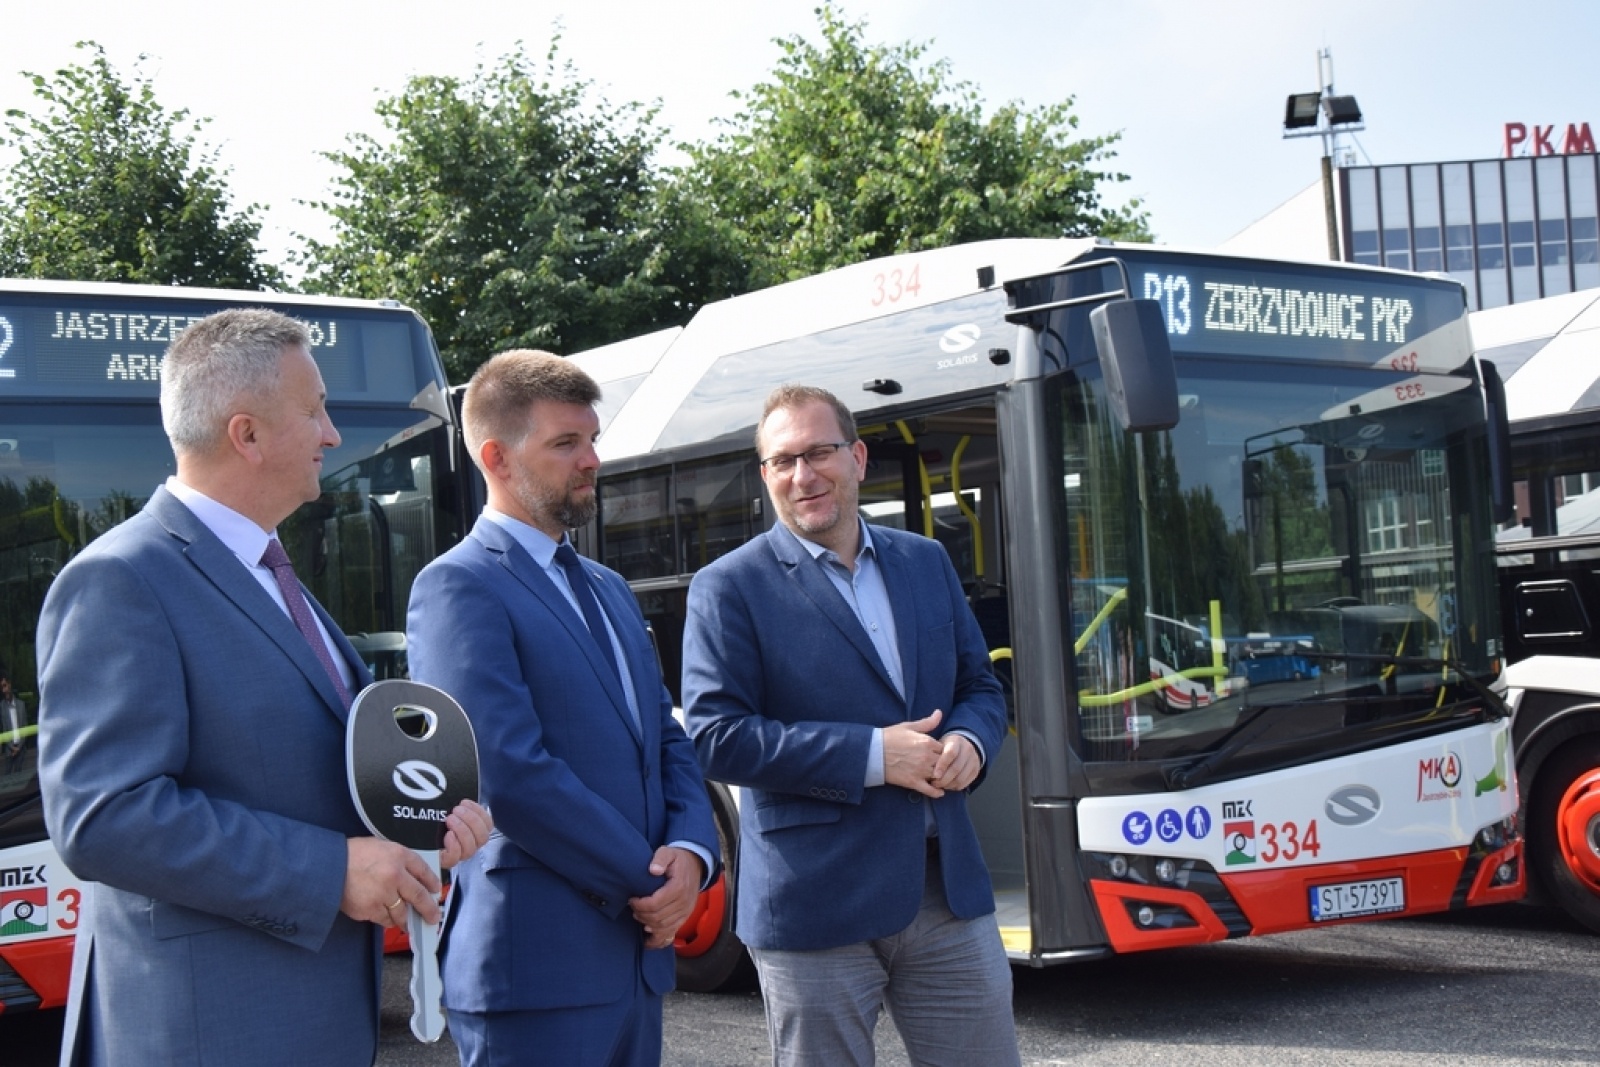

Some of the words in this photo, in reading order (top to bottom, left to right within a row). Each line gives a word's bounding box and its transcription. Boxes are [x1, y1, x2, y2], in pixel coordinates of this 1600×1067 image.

[1504, 121, 1597, 159] PKM
[871, 263, 922, 307] 334
[51, 311, 204, 342] JASTRZE
[1204, 282, 1365, 340] ZEBRZYDOWICE
[1371, 296, 1414, 343] PKP
[936, 353, 979, 370] SOLARIS
[393, 805, 448, 822] SOLARIS
[1260, 819, 1320, 863] 334
[56, 888, 81, 930] 3
[1322, 887, 1342, 912] ST
[1349, 880, 1398, 909] 5739T
